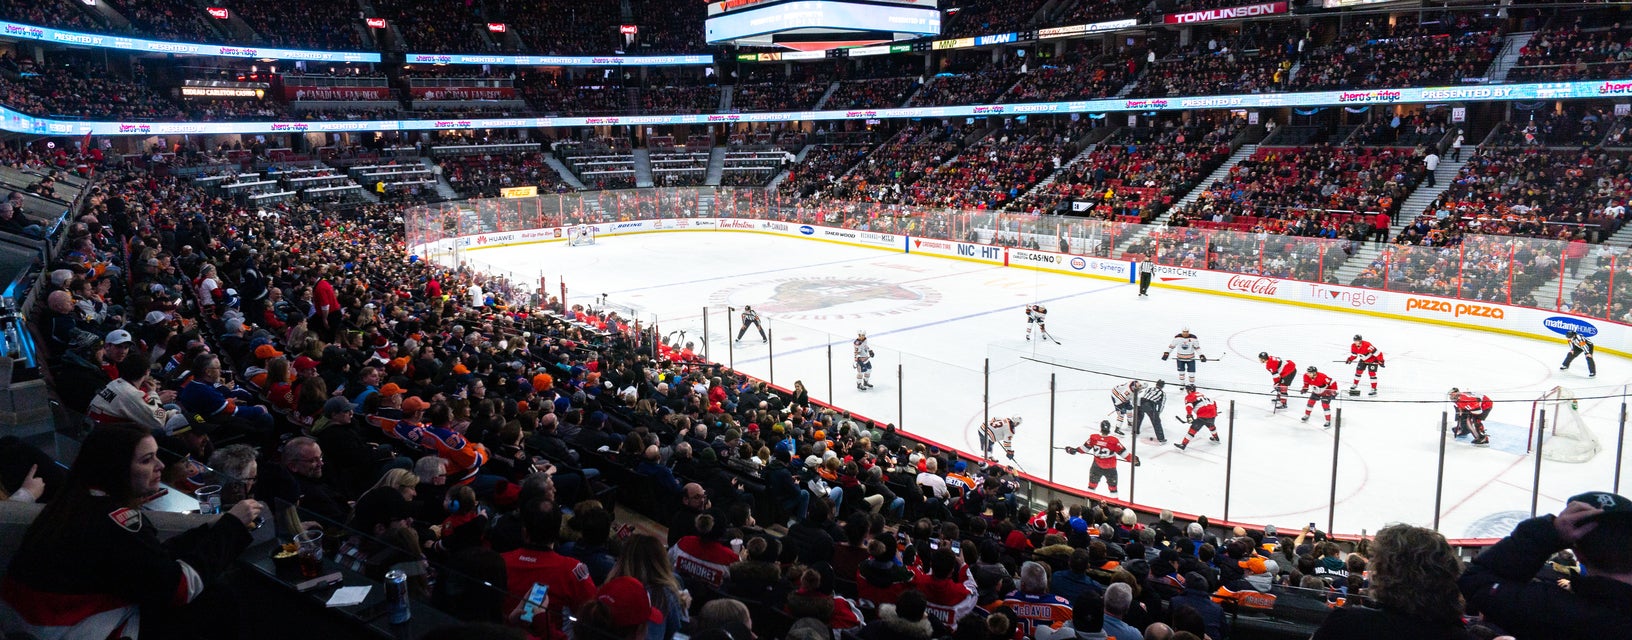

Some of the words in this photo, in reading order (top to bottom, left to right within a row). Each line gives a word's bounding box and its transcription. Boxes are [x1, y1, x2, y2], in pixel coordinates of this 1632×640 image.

[1175, 4, 1274, 23] TOMLINSON
[54, 33, 91, 43] PRESENTED
[148, 43, 186, 51] PRESENTED
[1421, 89, 1491, 99] PRESENTED
[1181, 99, 1227, 107] PRESENTED
[720, 220, 731, 228] Tim
[732, 220, 754, 229] Hortons
[957, 243, 975, 256] NIC
[982, 246, 1000, 259] HIT
[1028, 253, 1055, 263] CASINO
[1100, 262, 1125, 273] Synergy
[1228, 275, 1280, 295] Coca-Cola
[1406, 298, 1452, 312] pizza
[1455, 303, 1504, 319] pizza
[1013, 605, 1052, 618] McDAVID
